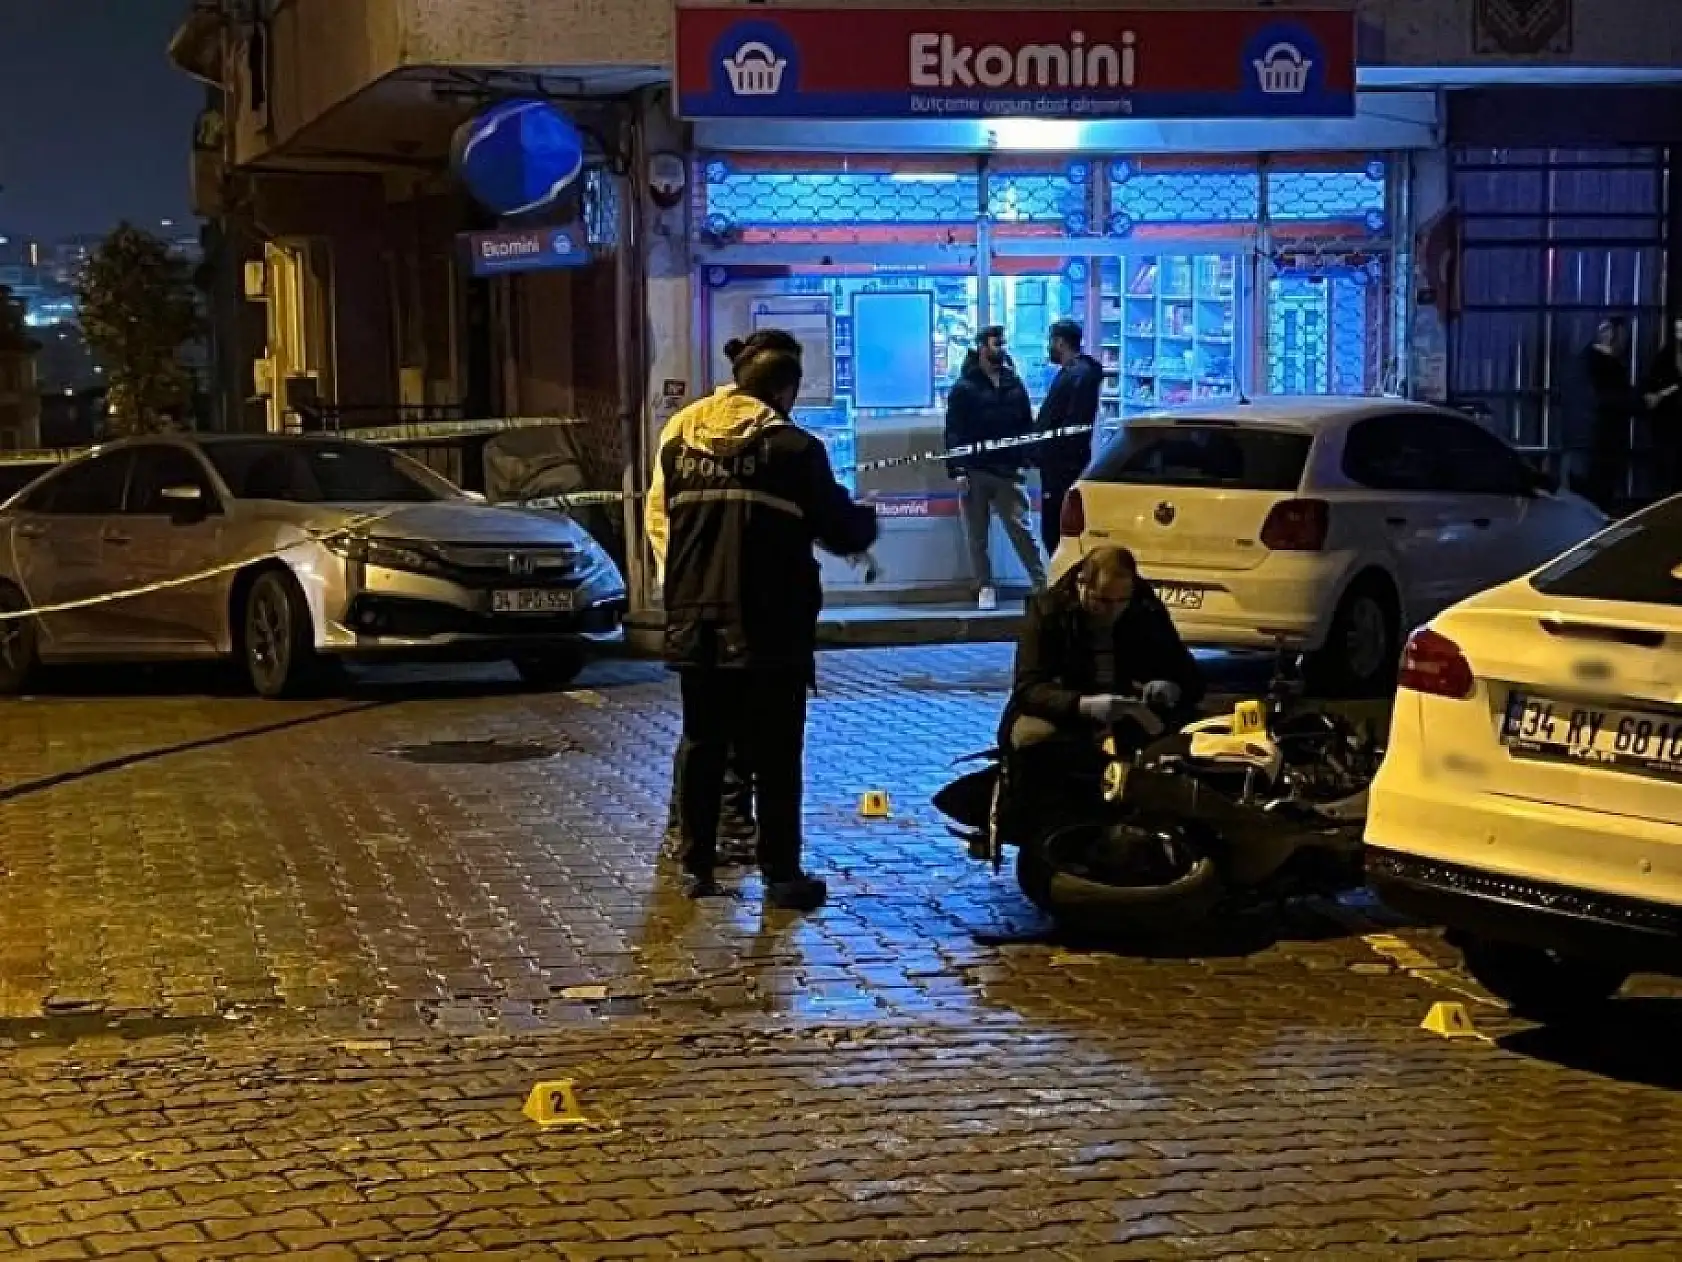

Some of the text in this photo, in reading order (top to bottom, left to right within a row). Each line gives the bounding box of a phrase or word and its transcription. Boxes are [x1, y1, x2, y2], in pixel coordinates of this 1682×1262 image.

[909, 30, 1135, 87] Ekomini
[1520, 701, 1555, 740] 34
[1569, 708, 1606, 750] RY
[549, 1090, 568, 1114] 2
